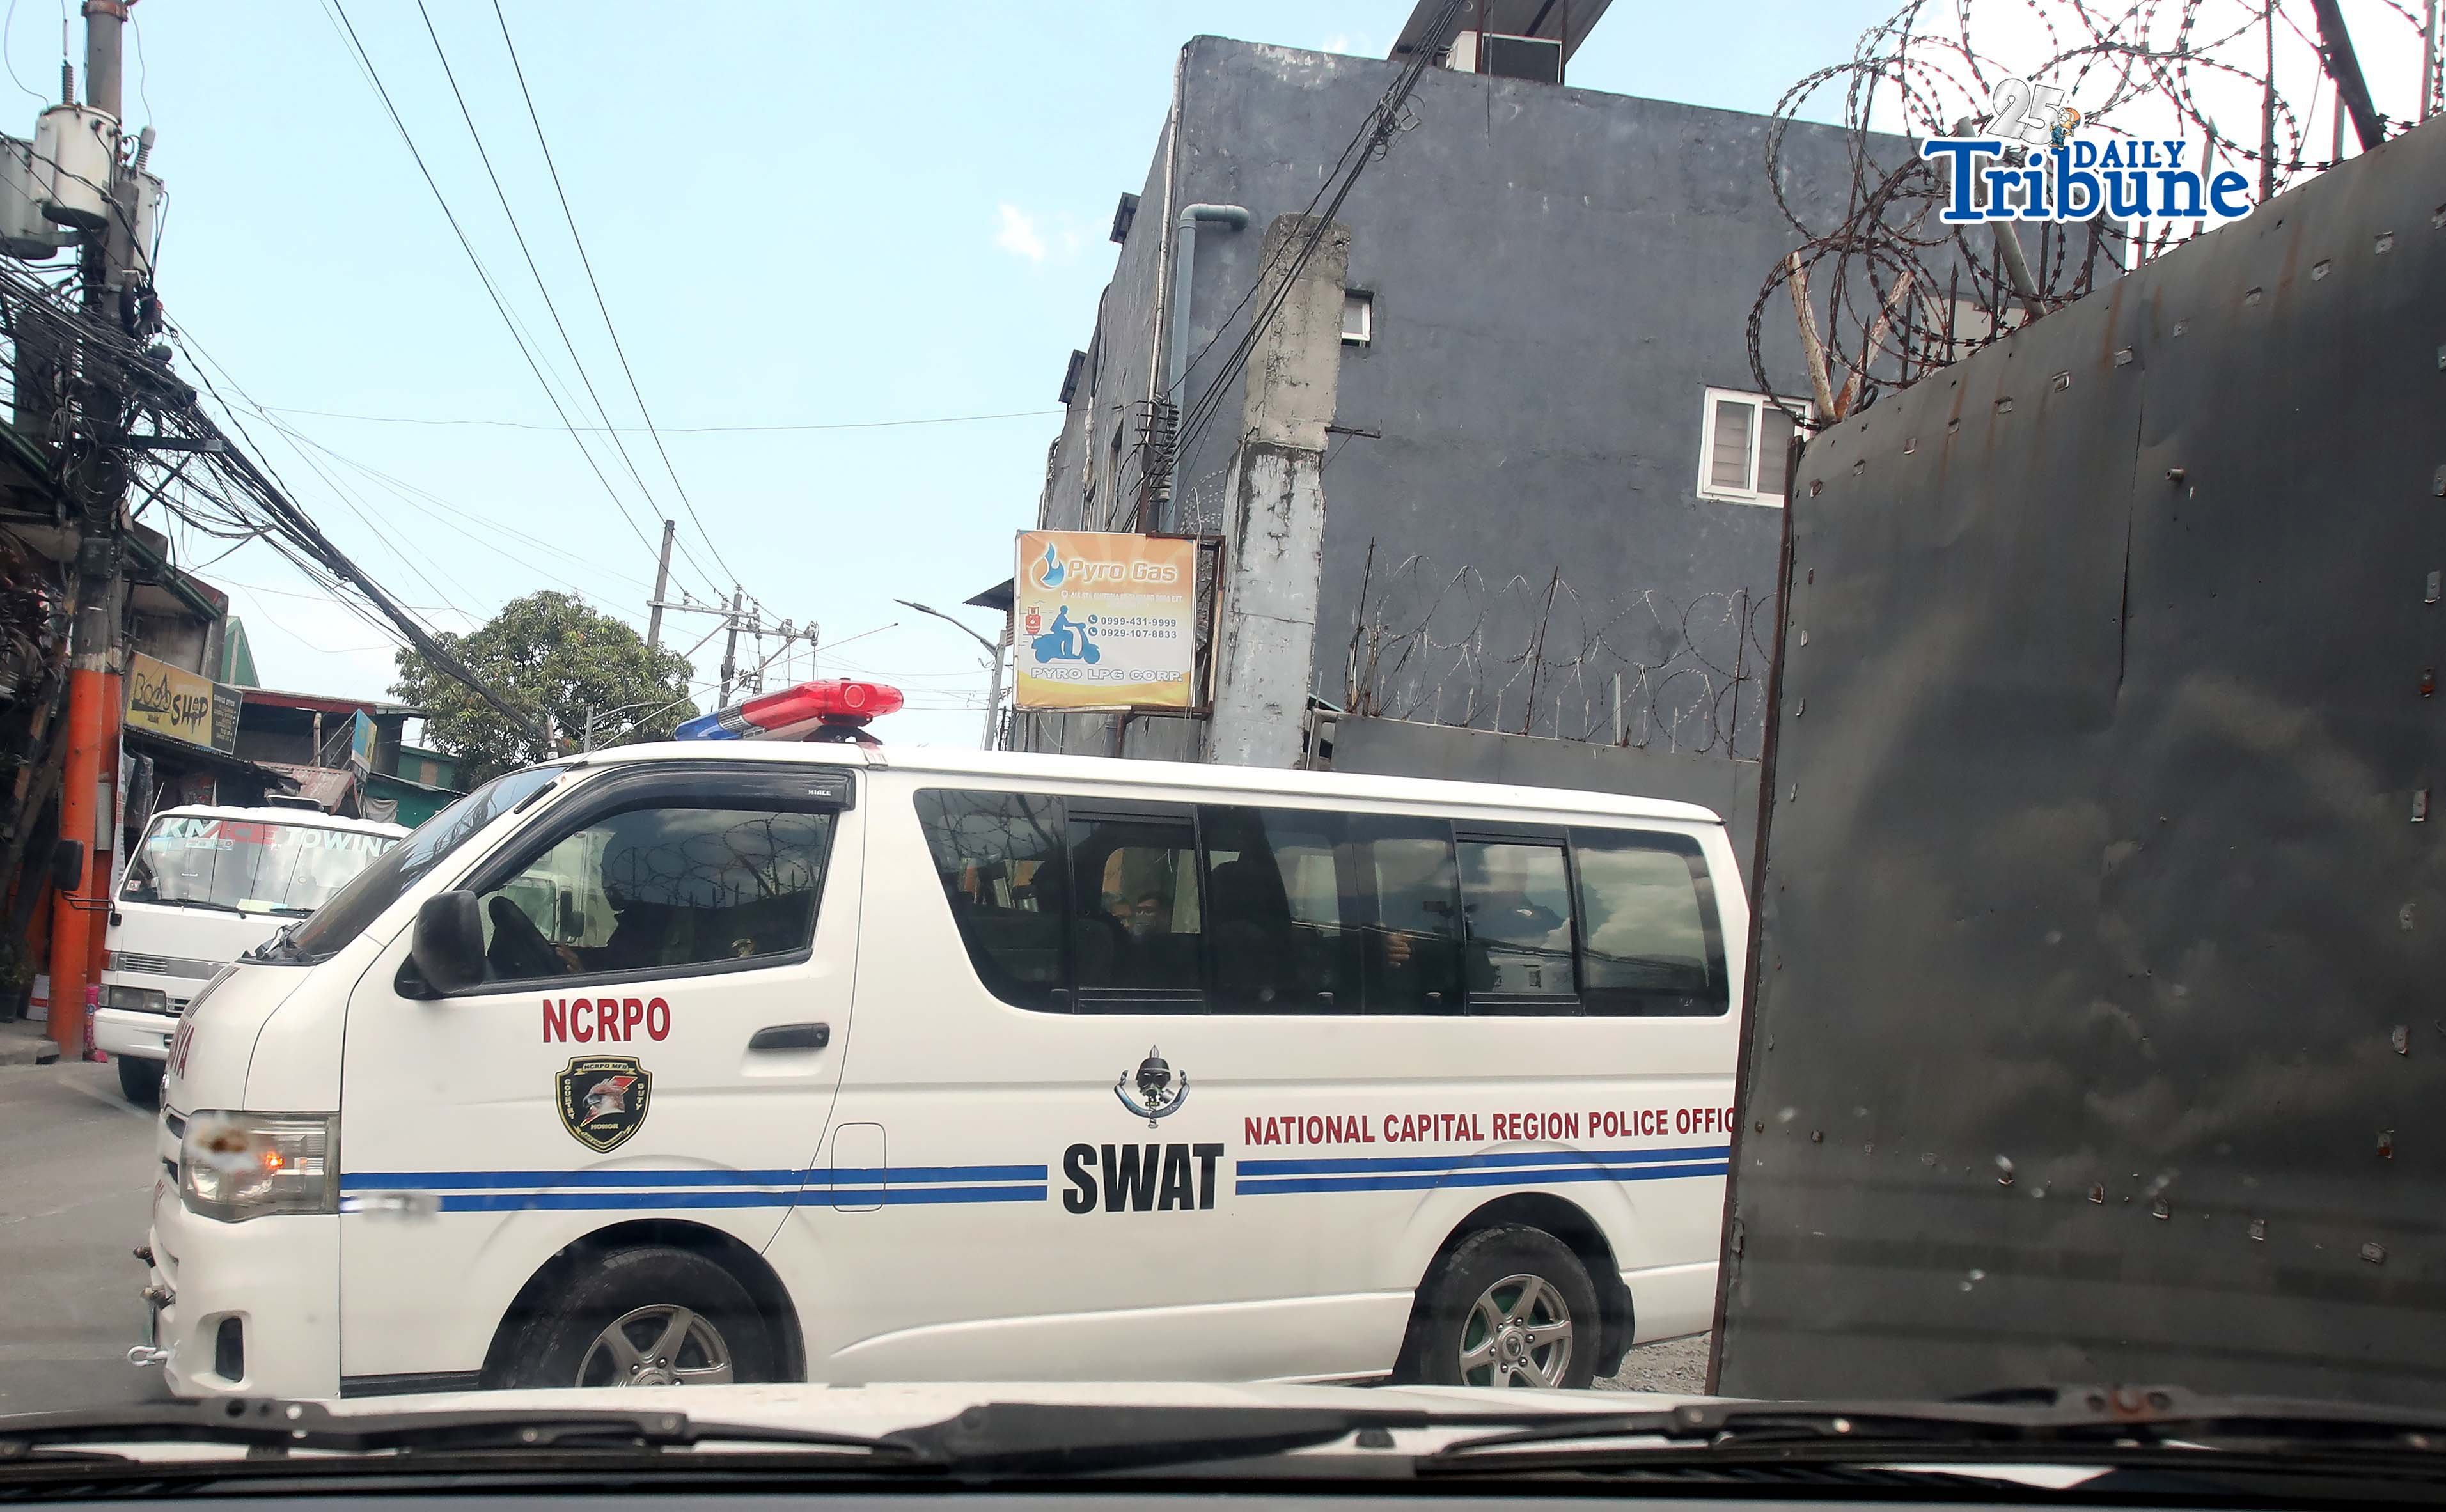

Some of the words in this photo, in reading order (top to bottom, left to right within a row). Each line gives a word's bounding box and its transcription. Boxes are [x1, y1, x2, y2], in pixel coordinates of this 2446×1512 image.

[1067, 560, 1125, 583] Pyro
[1133, 562, 1177, 582] Gas
[1101, 616, 1177, 627] 0999-431-9999
[1101, 629, 1177, 639] 0929-107-8833
[1031, 667, 1082, 680] PYRO
[1088, 669, 1124, 680] LPG
[1129, 670, 1183, 682] CORP.
[543, 997, 671, 1043] NCRPO
[636, 1083, 645, 1111] DUTY
[1244, 1116, 1375, 1146] NATIONAL
[1383, 1114, 1484, 1142] CAPITAL
[1493, 1112, 1579, 1140] REGION
[1588, 1110, 1668, 1138] POLICE
[1063, 1143, 1225, 1214] SWAT
